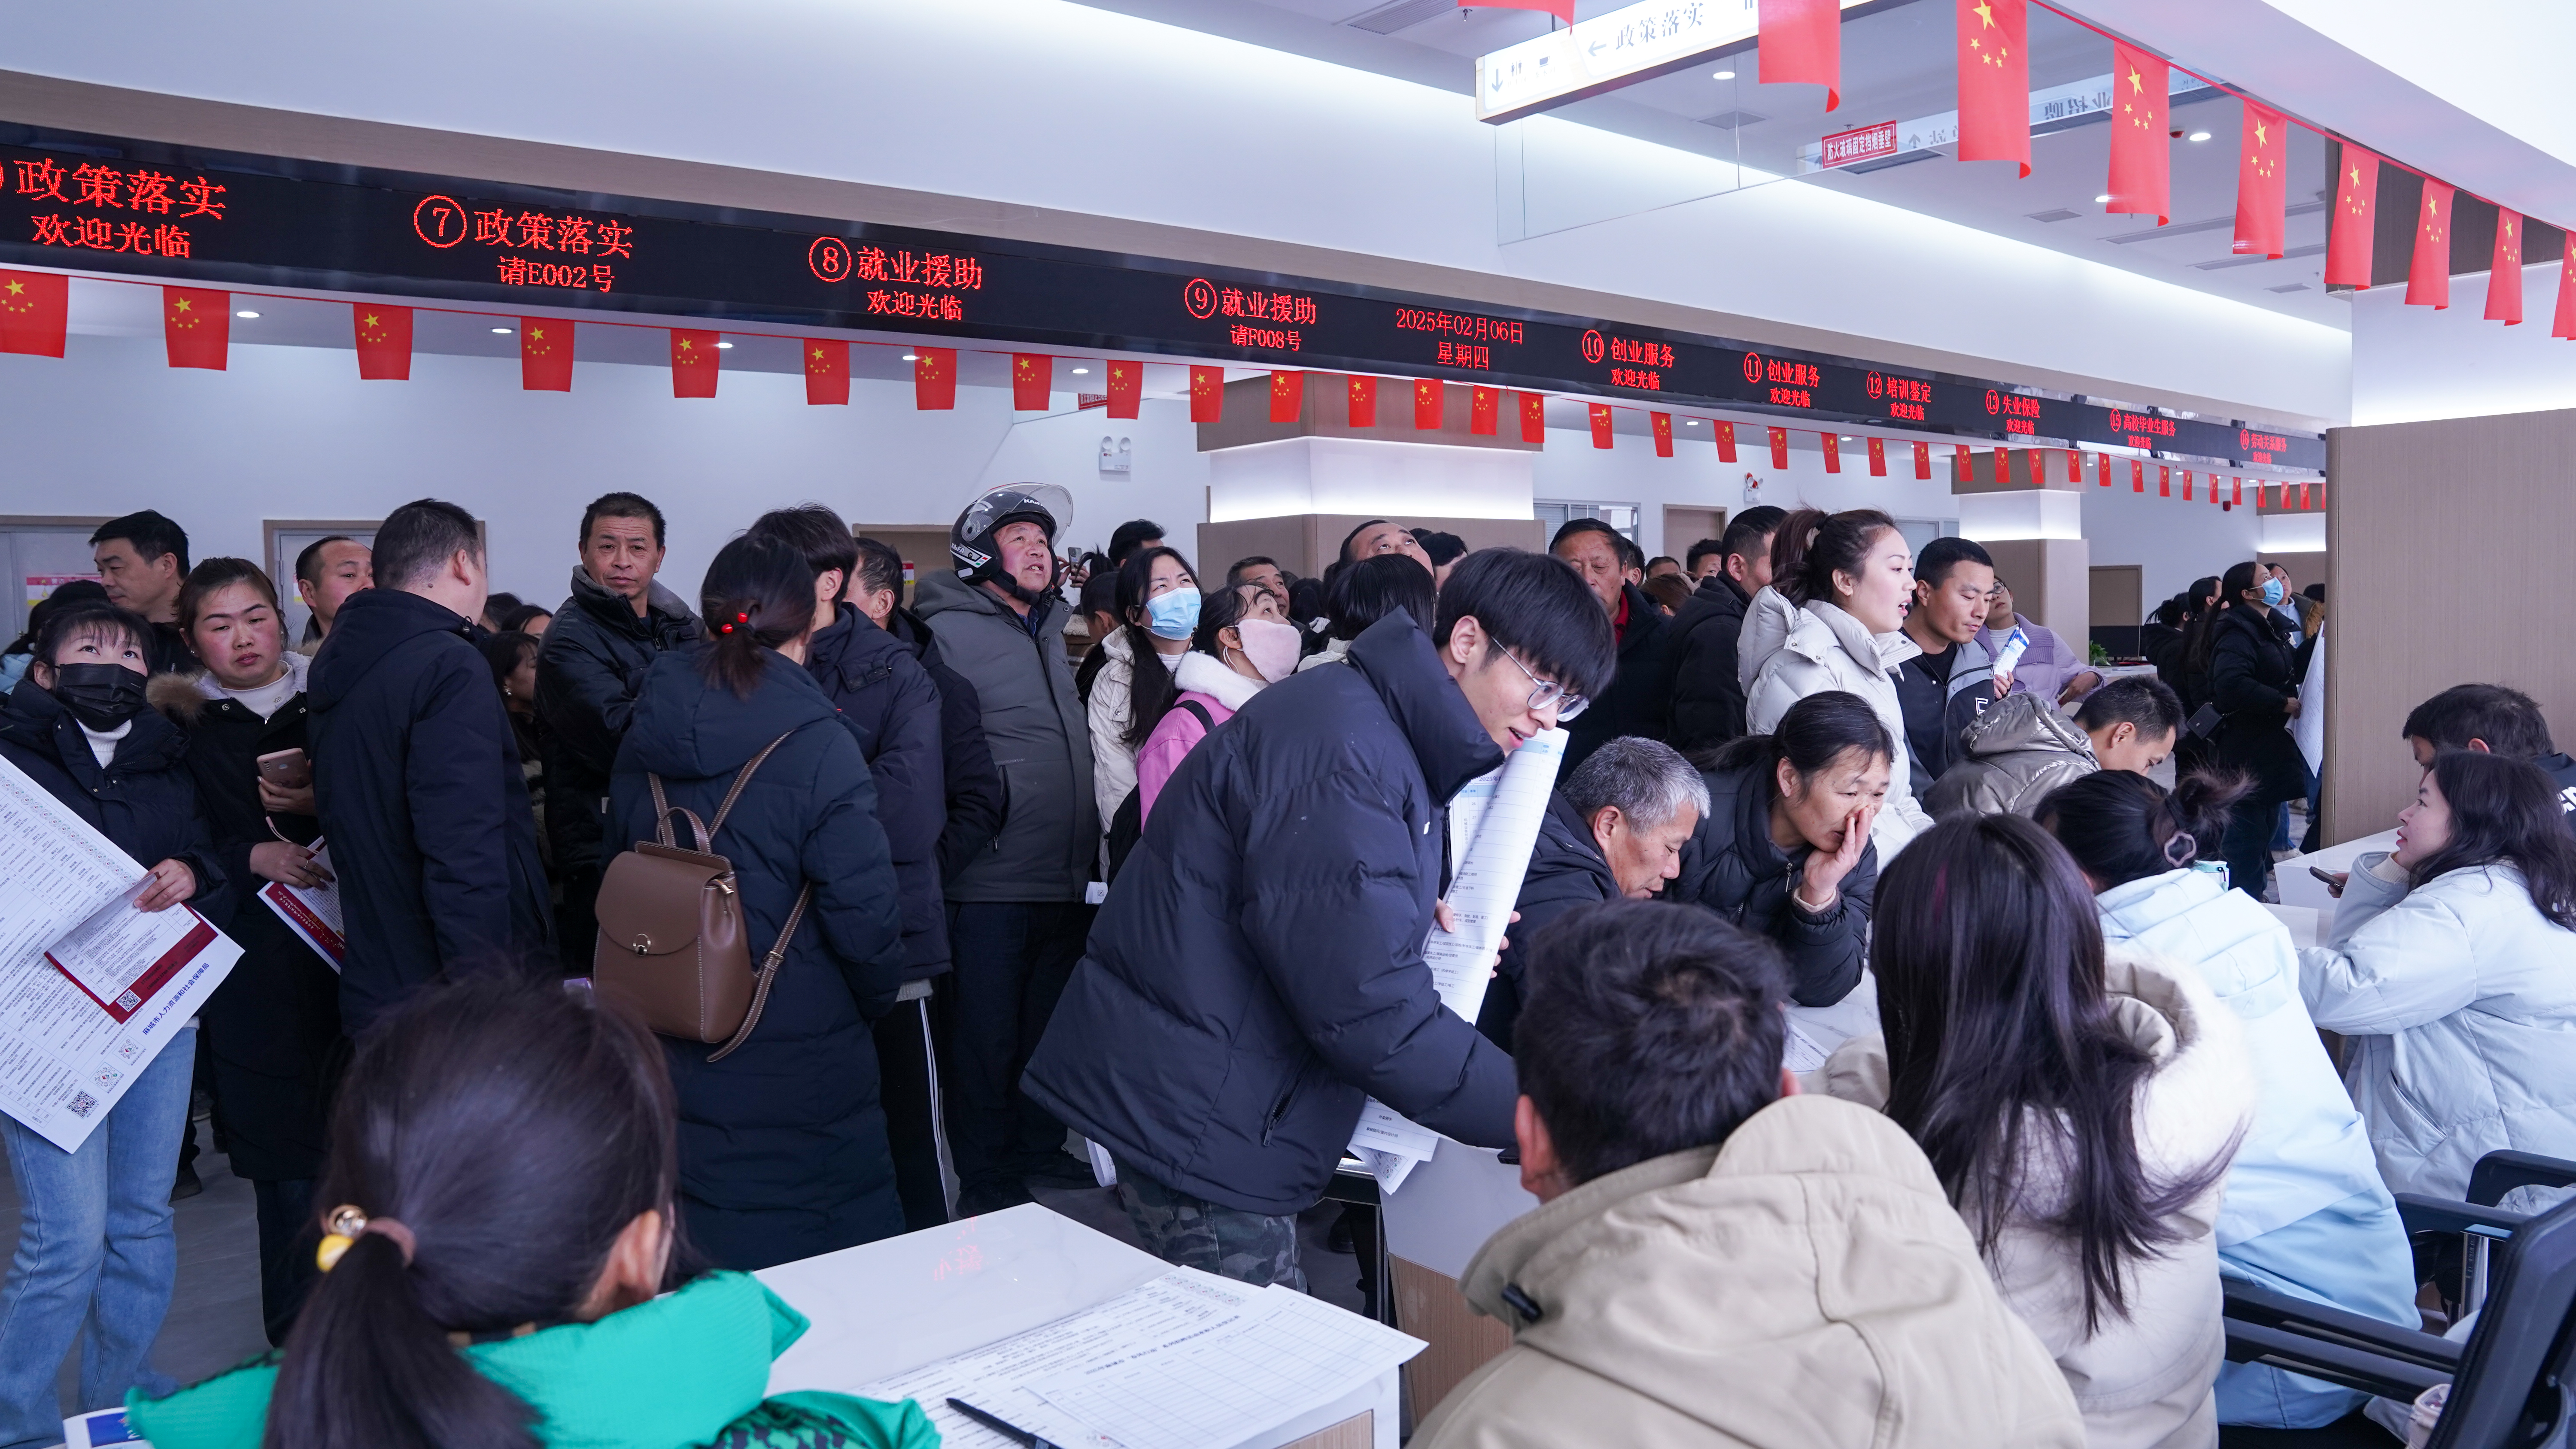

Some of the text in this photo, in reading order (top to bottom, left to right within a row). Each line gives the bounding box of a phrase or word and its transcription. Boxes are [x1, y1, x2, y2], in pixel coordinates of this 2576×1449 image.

[1616, 3, 1704, 51] 政策落实
[1827, 129, 1891, 161] 防火玻璃固定挡烟垂壁
[14, 158, 226, 220] 政策落实
[32, 214, 190, 258] 欢迎光临
[474, 209, 632, 258] 政策落实
[497, 256, 615, 293] 请E002号
[857, 246, 982, 290] 就业援助
[867, 289, 962, 320] 欢迎光临
[1221, 287, 1316, 325] 就业援助
[1230, 324, 1301, 351] 请F008号
[1396, 309, 1523, 345] 2025年02月06日
[1437, 342, 1488, 370] 星期四
[1611, 337, 1674, 369] 创业服务
[1611, 368, 1660, 390] 欢迎光临
[1767, 359, 1820, 388] 创业服务
[1770, 387, 1810, 407] 欢迎光临
[1886, 377, 1931, 403] 培训鉴定
[1890, 403, 1925, 421] 欢迎光临
[2002, 394, 2040, 419] 失业保险
[2006, 418, 2035, 435] 欢迎光临
[2123, 413, 2176, 437] 高校毕业生服务
[2128, 435, 2151, 449] 欢迎光临
[2251, 433, 2287, 452] 劳动关系服务
[140, 961, 211, 1036] 麻城市人力资源和社会保障局
